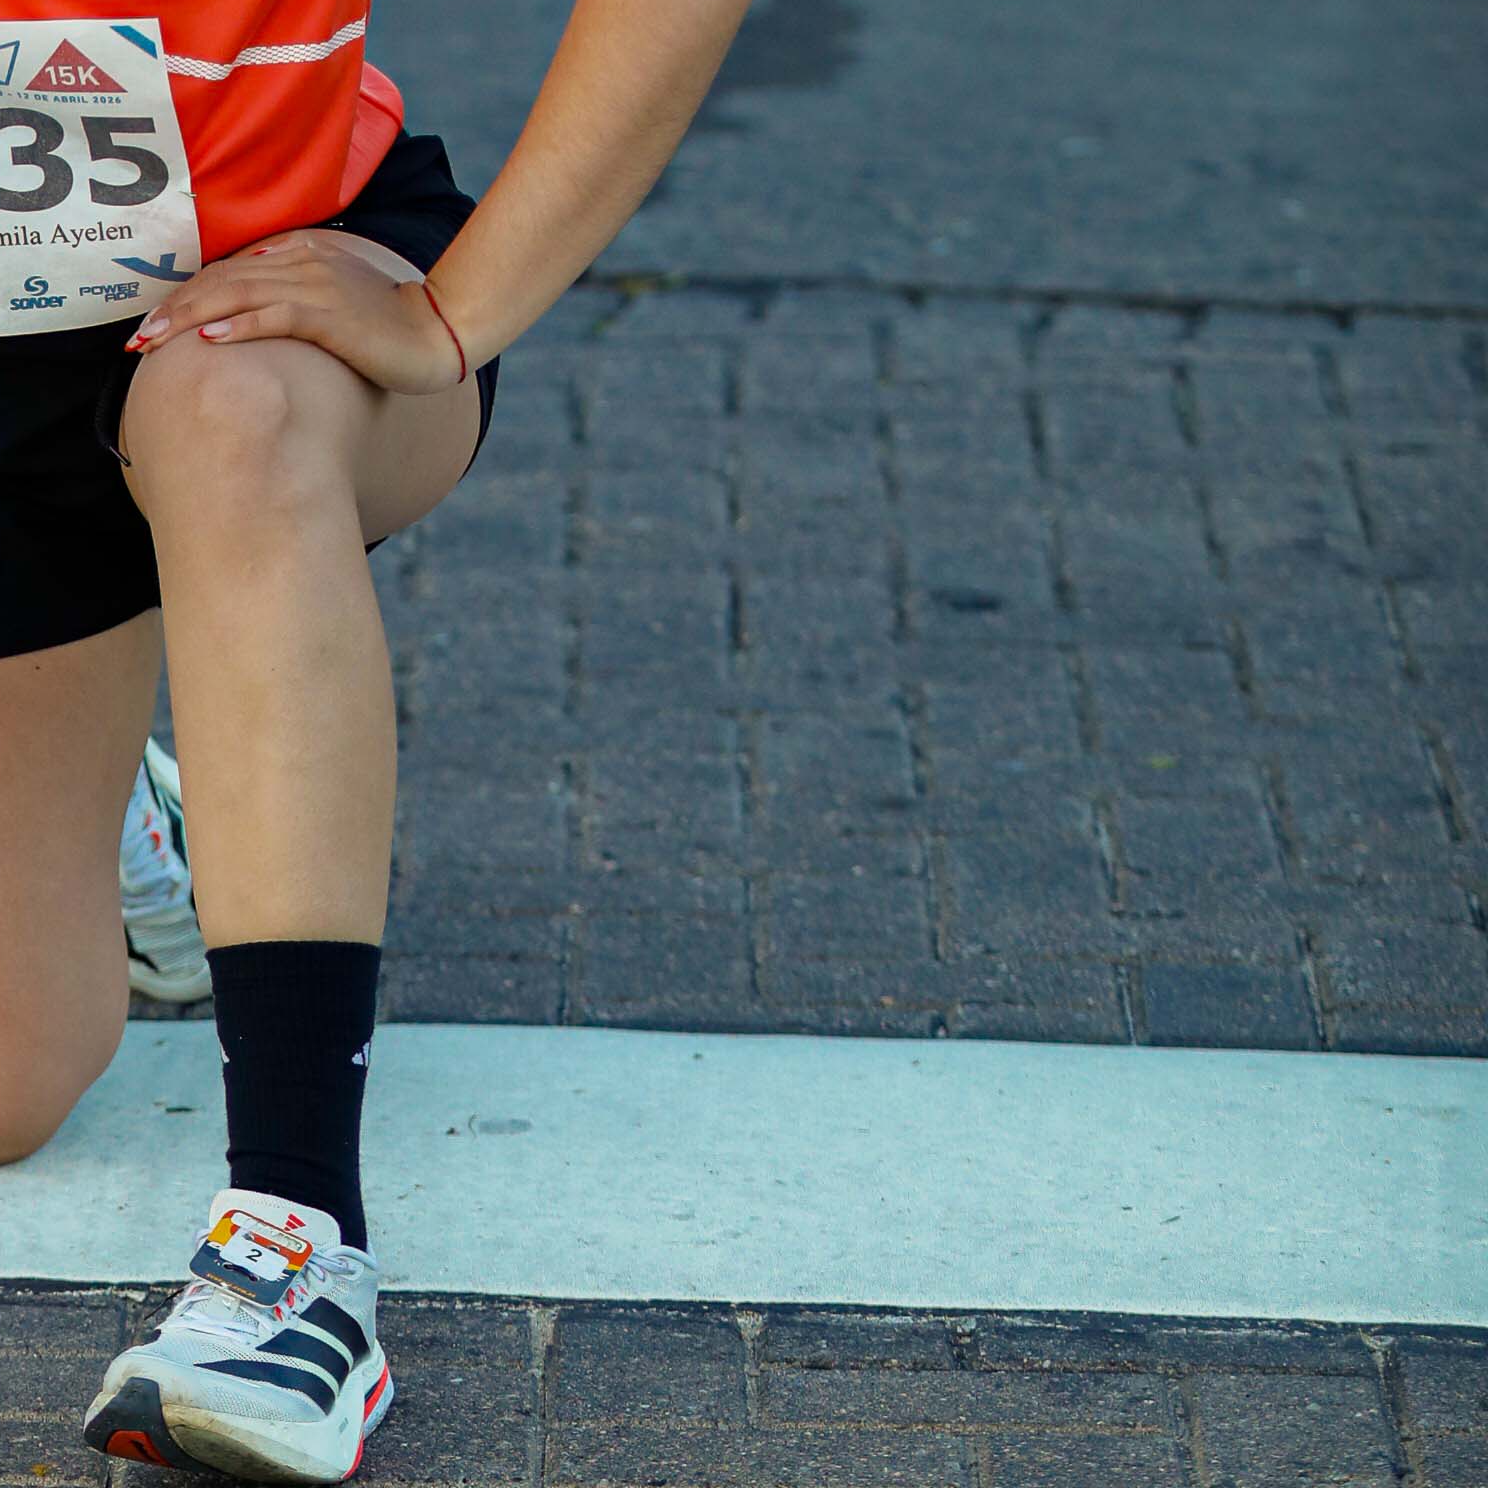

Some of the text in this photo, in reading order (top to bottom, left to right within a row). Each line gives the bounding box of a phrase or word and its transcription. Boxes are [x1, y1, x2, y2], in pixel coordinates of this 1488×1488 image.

[44, 64, 101, 88] 15K
[53, 95, 89, 104] ABRIL
[92, 95, 123, 105] 2026
[50, 221, 134, 248] Ayelen
[79, 281, 141, 298] POWER
[245, 1248, 263, 1263] 2
